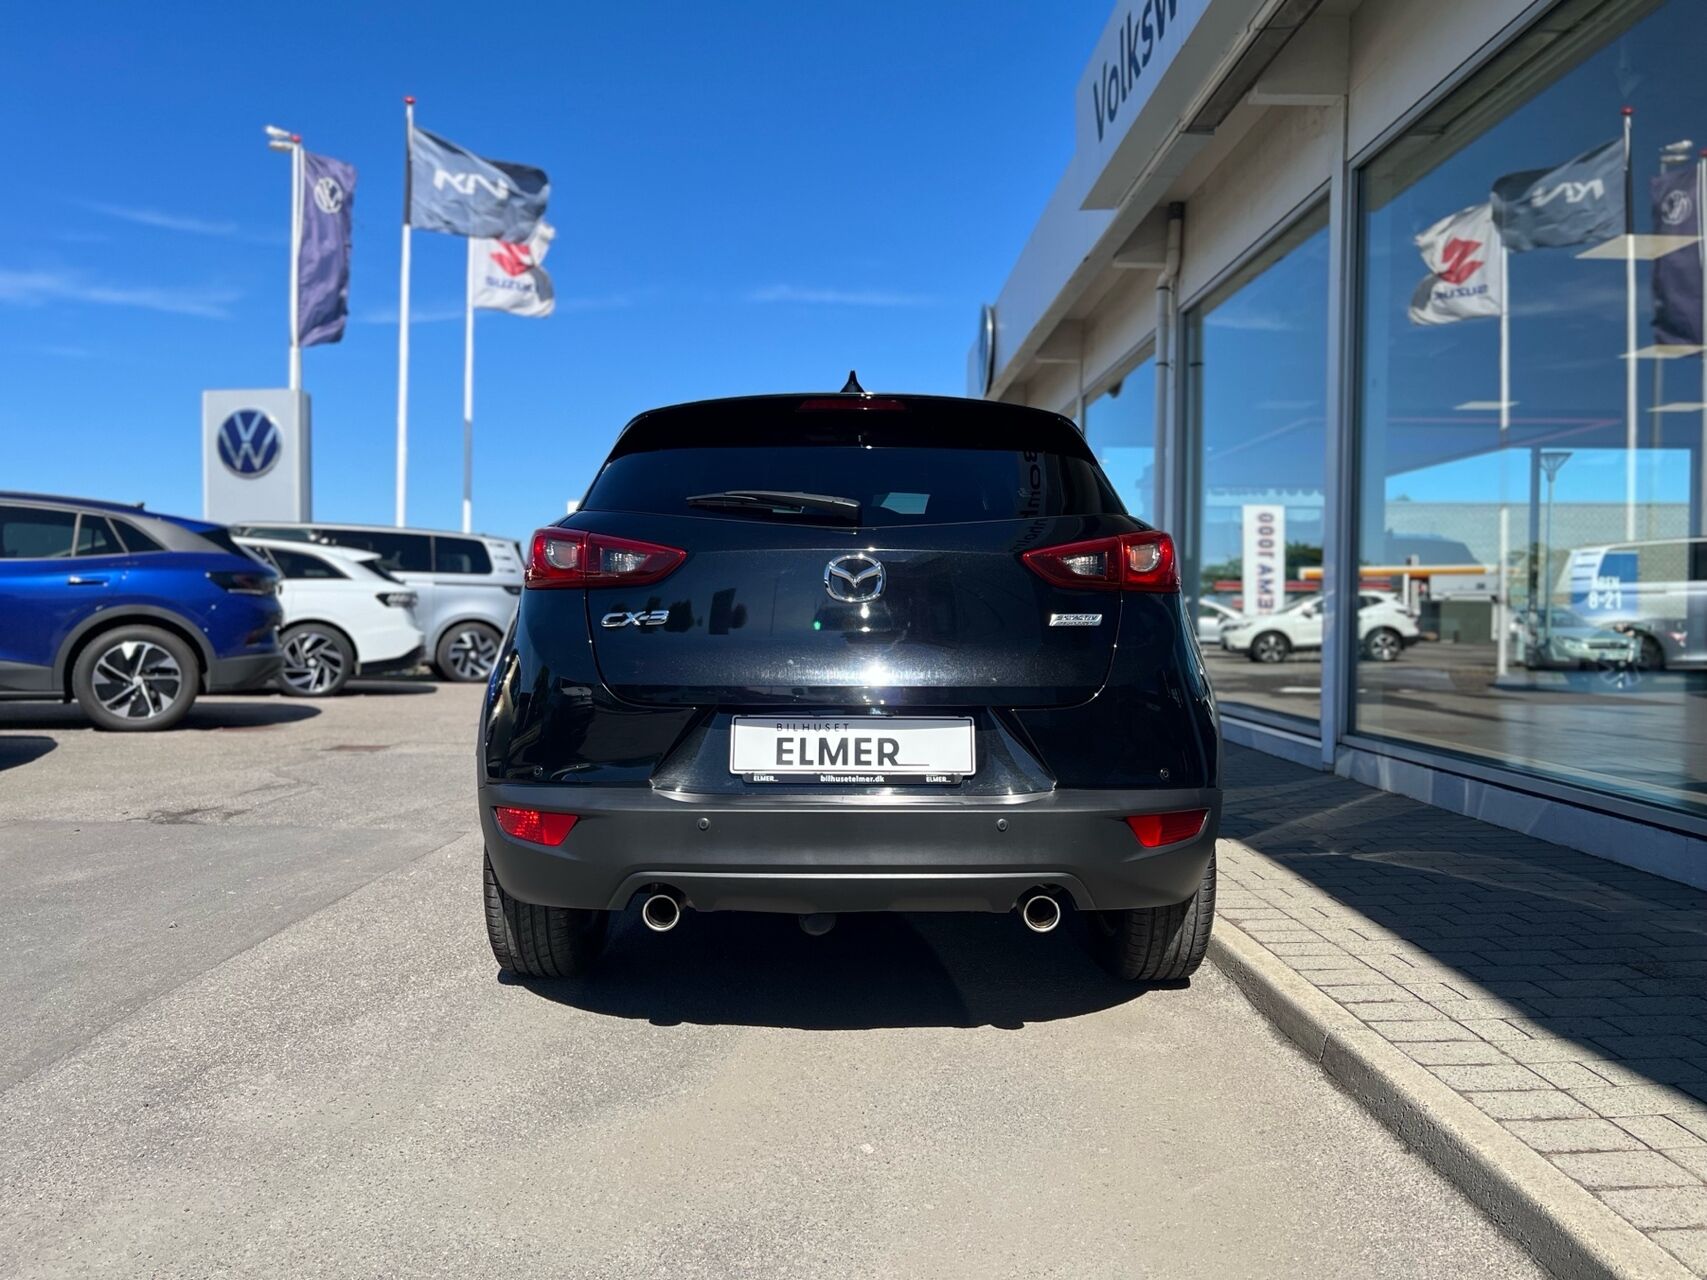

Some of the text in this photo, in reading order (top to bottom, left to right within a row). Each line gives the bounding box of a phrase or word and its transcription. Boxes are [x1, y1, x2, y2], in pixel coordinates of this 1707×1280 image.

[485, 275, 533, 292] SUZUK
[601, 610, 669, 628] CX-3
[776, 723, 849, 732] BILHUSET
[776, 737, 900, 766] ELMER
[820, 775, 885, 783] bilhusetelmer.dk
